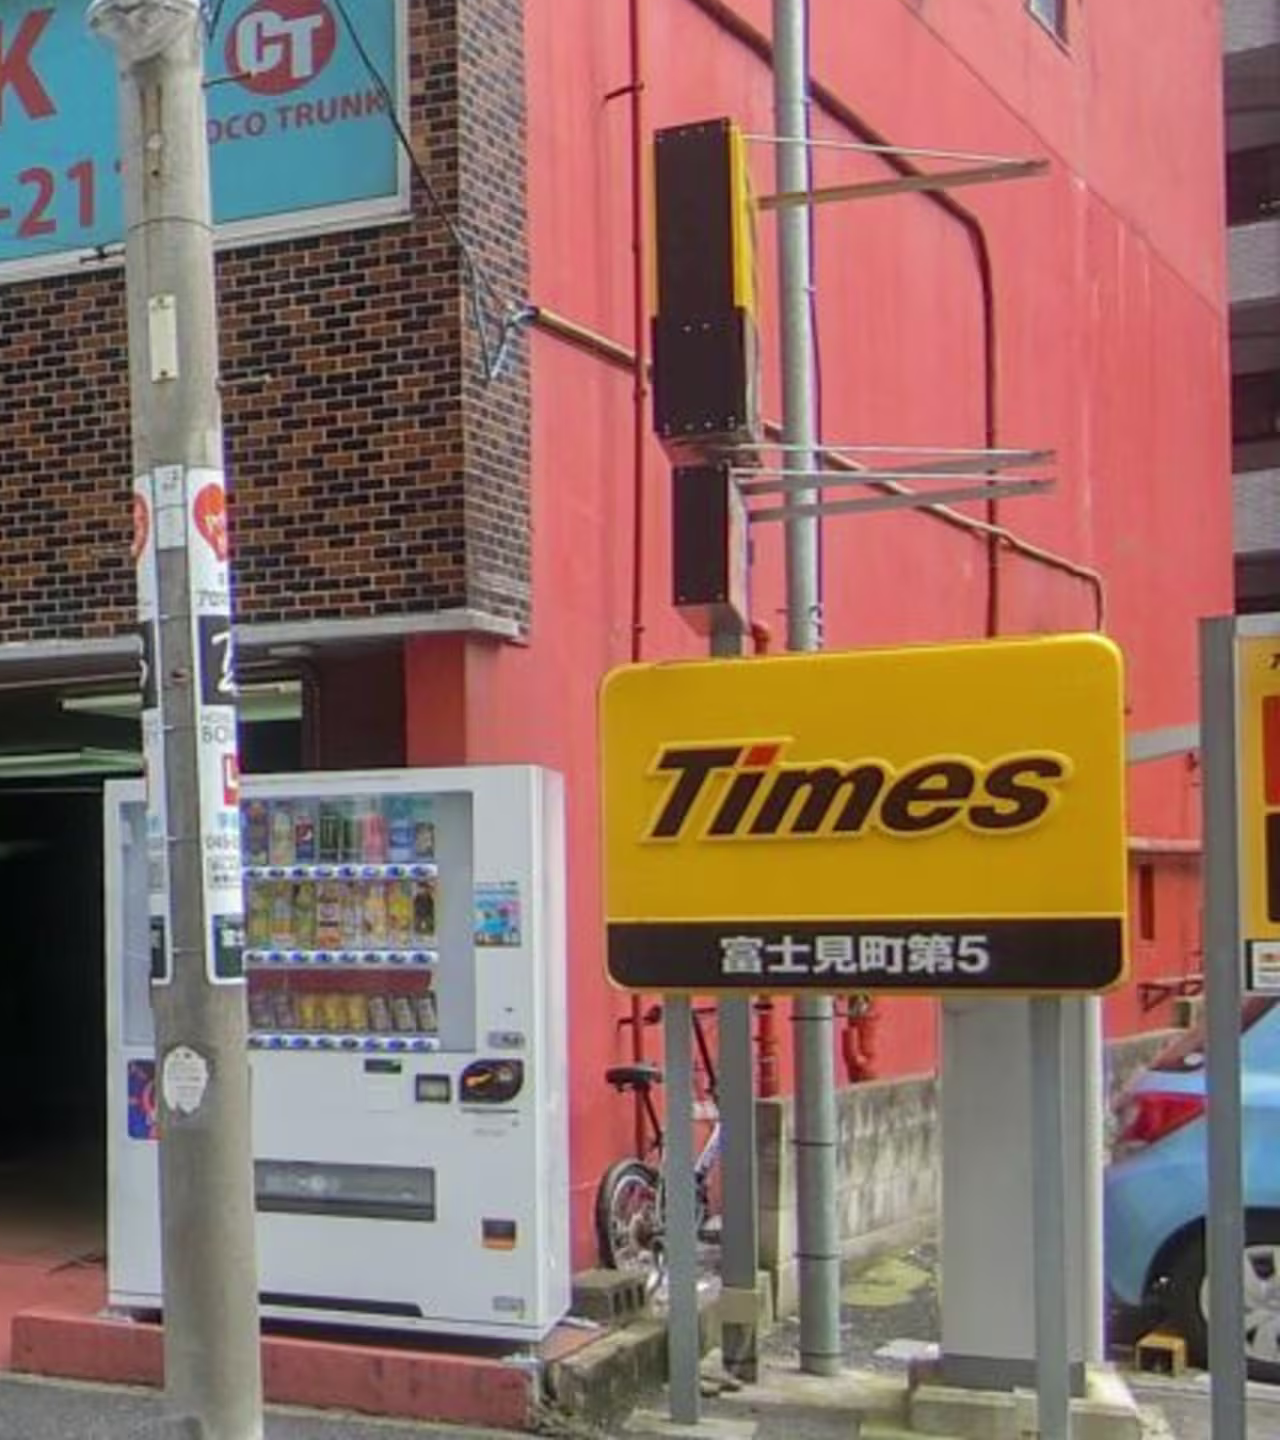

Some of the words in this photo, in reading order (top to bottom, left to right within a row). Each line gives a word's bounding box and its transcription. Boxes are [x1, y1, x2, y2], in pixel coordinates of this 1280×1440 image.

[236, 11, 324, 80] CT
[206, 112, 267, 146] OCO
[276, 86, 390, 131] TRUNK
[649, 744, 1063, 839] Times
[719, 933, 990, 975] 富士見町第5
